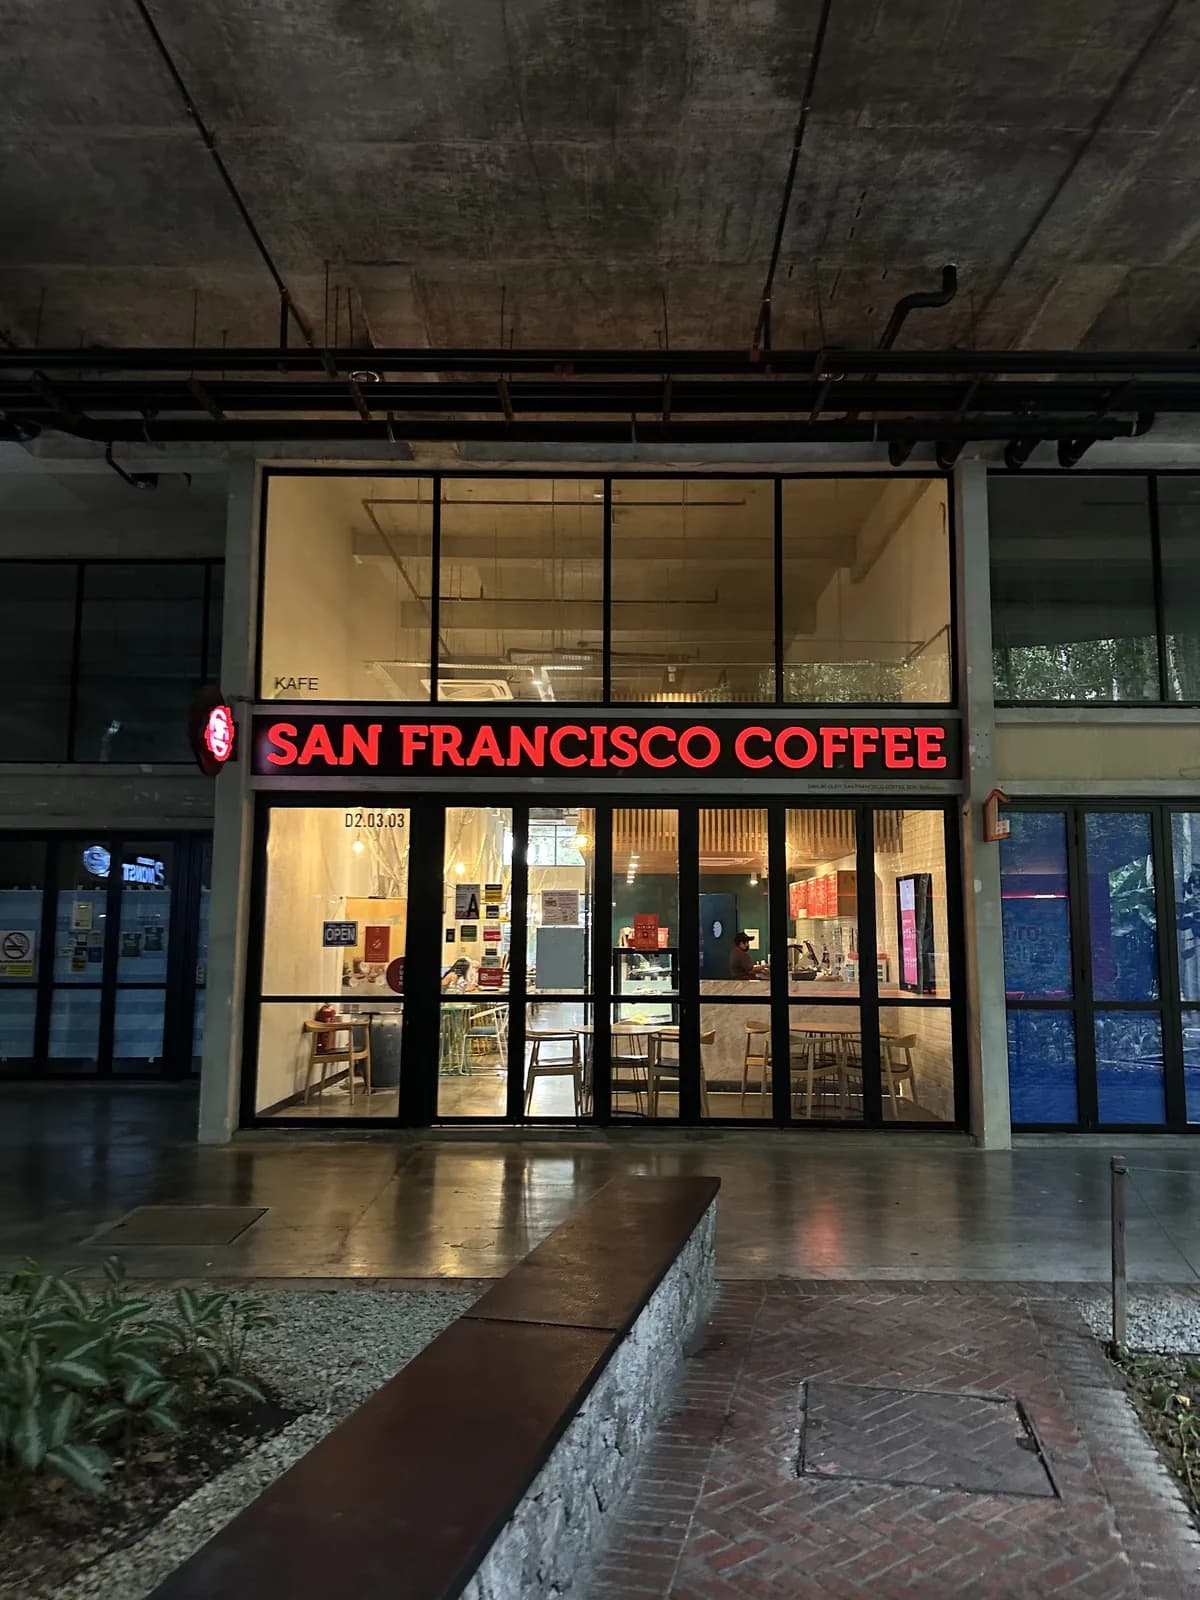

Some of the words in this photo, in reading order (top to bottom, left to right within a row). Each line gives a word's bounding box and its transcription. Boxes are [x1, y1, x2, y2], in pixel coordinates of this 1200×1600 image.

[274, 676, 318, 691] KAFE
[265, 722, 382, 766] SAN
[400, 725, 720, 767] FRANCISCO
[736, 726, 947, 769] COFFEE
[345, 813, 405, 828] D2.03.03
[468, 893, 480, 917] A
[326, 928, 355, 941] OPEN
